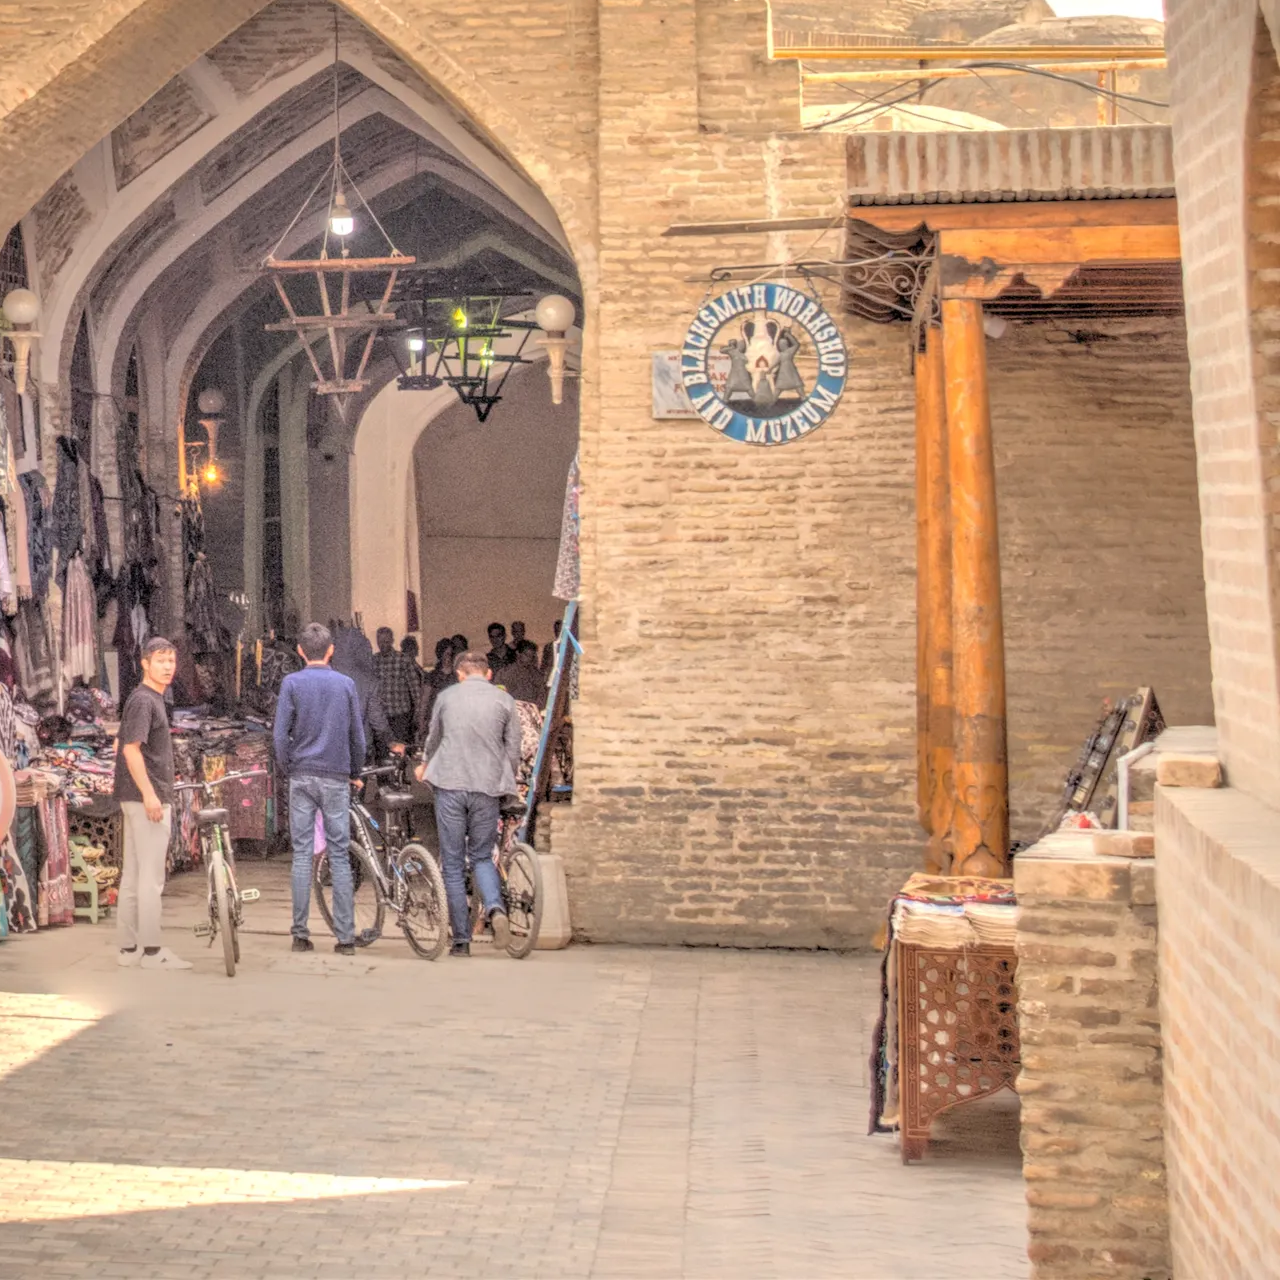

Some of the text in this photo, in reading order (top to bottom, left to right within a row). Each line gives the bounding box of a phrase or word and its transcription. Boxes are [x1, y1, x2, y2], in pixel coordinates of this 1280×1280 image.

[682, 284, 846, 387] BLACKSMITH WORKSHOP
[691, 384, 839, 444] AND MUZEUM
